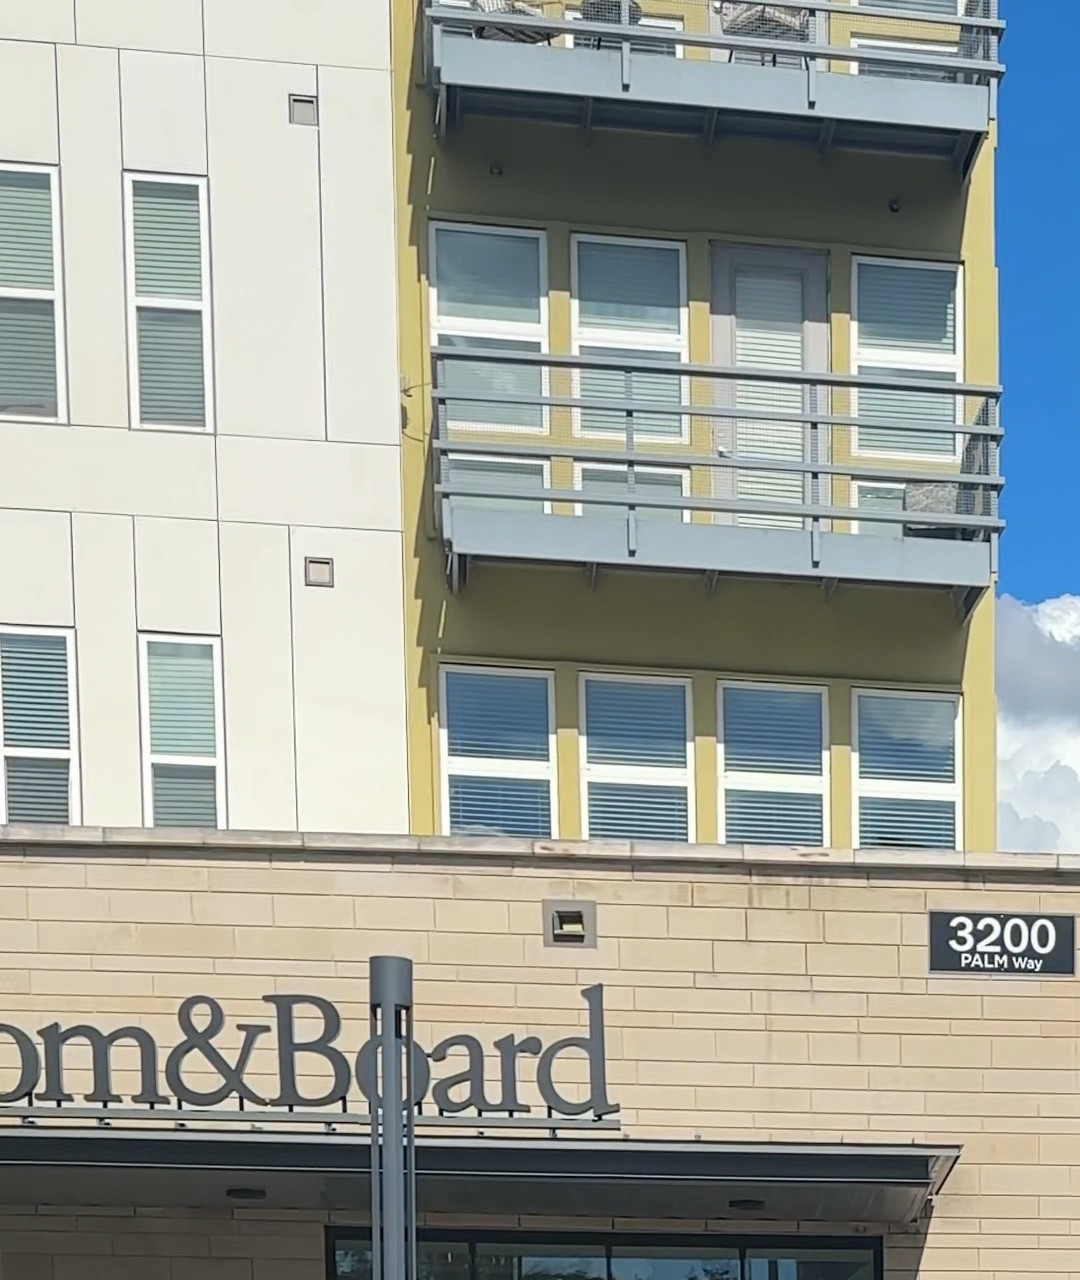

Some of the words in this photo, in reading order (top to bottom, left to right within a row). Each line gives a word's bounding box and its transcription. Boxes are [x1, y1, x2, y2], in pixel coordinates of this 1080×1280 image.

[948, 916, 1056, 954] 3200
[960, 953, 1008, 969] PALM
[1012, 956, 1043, 971] Way
